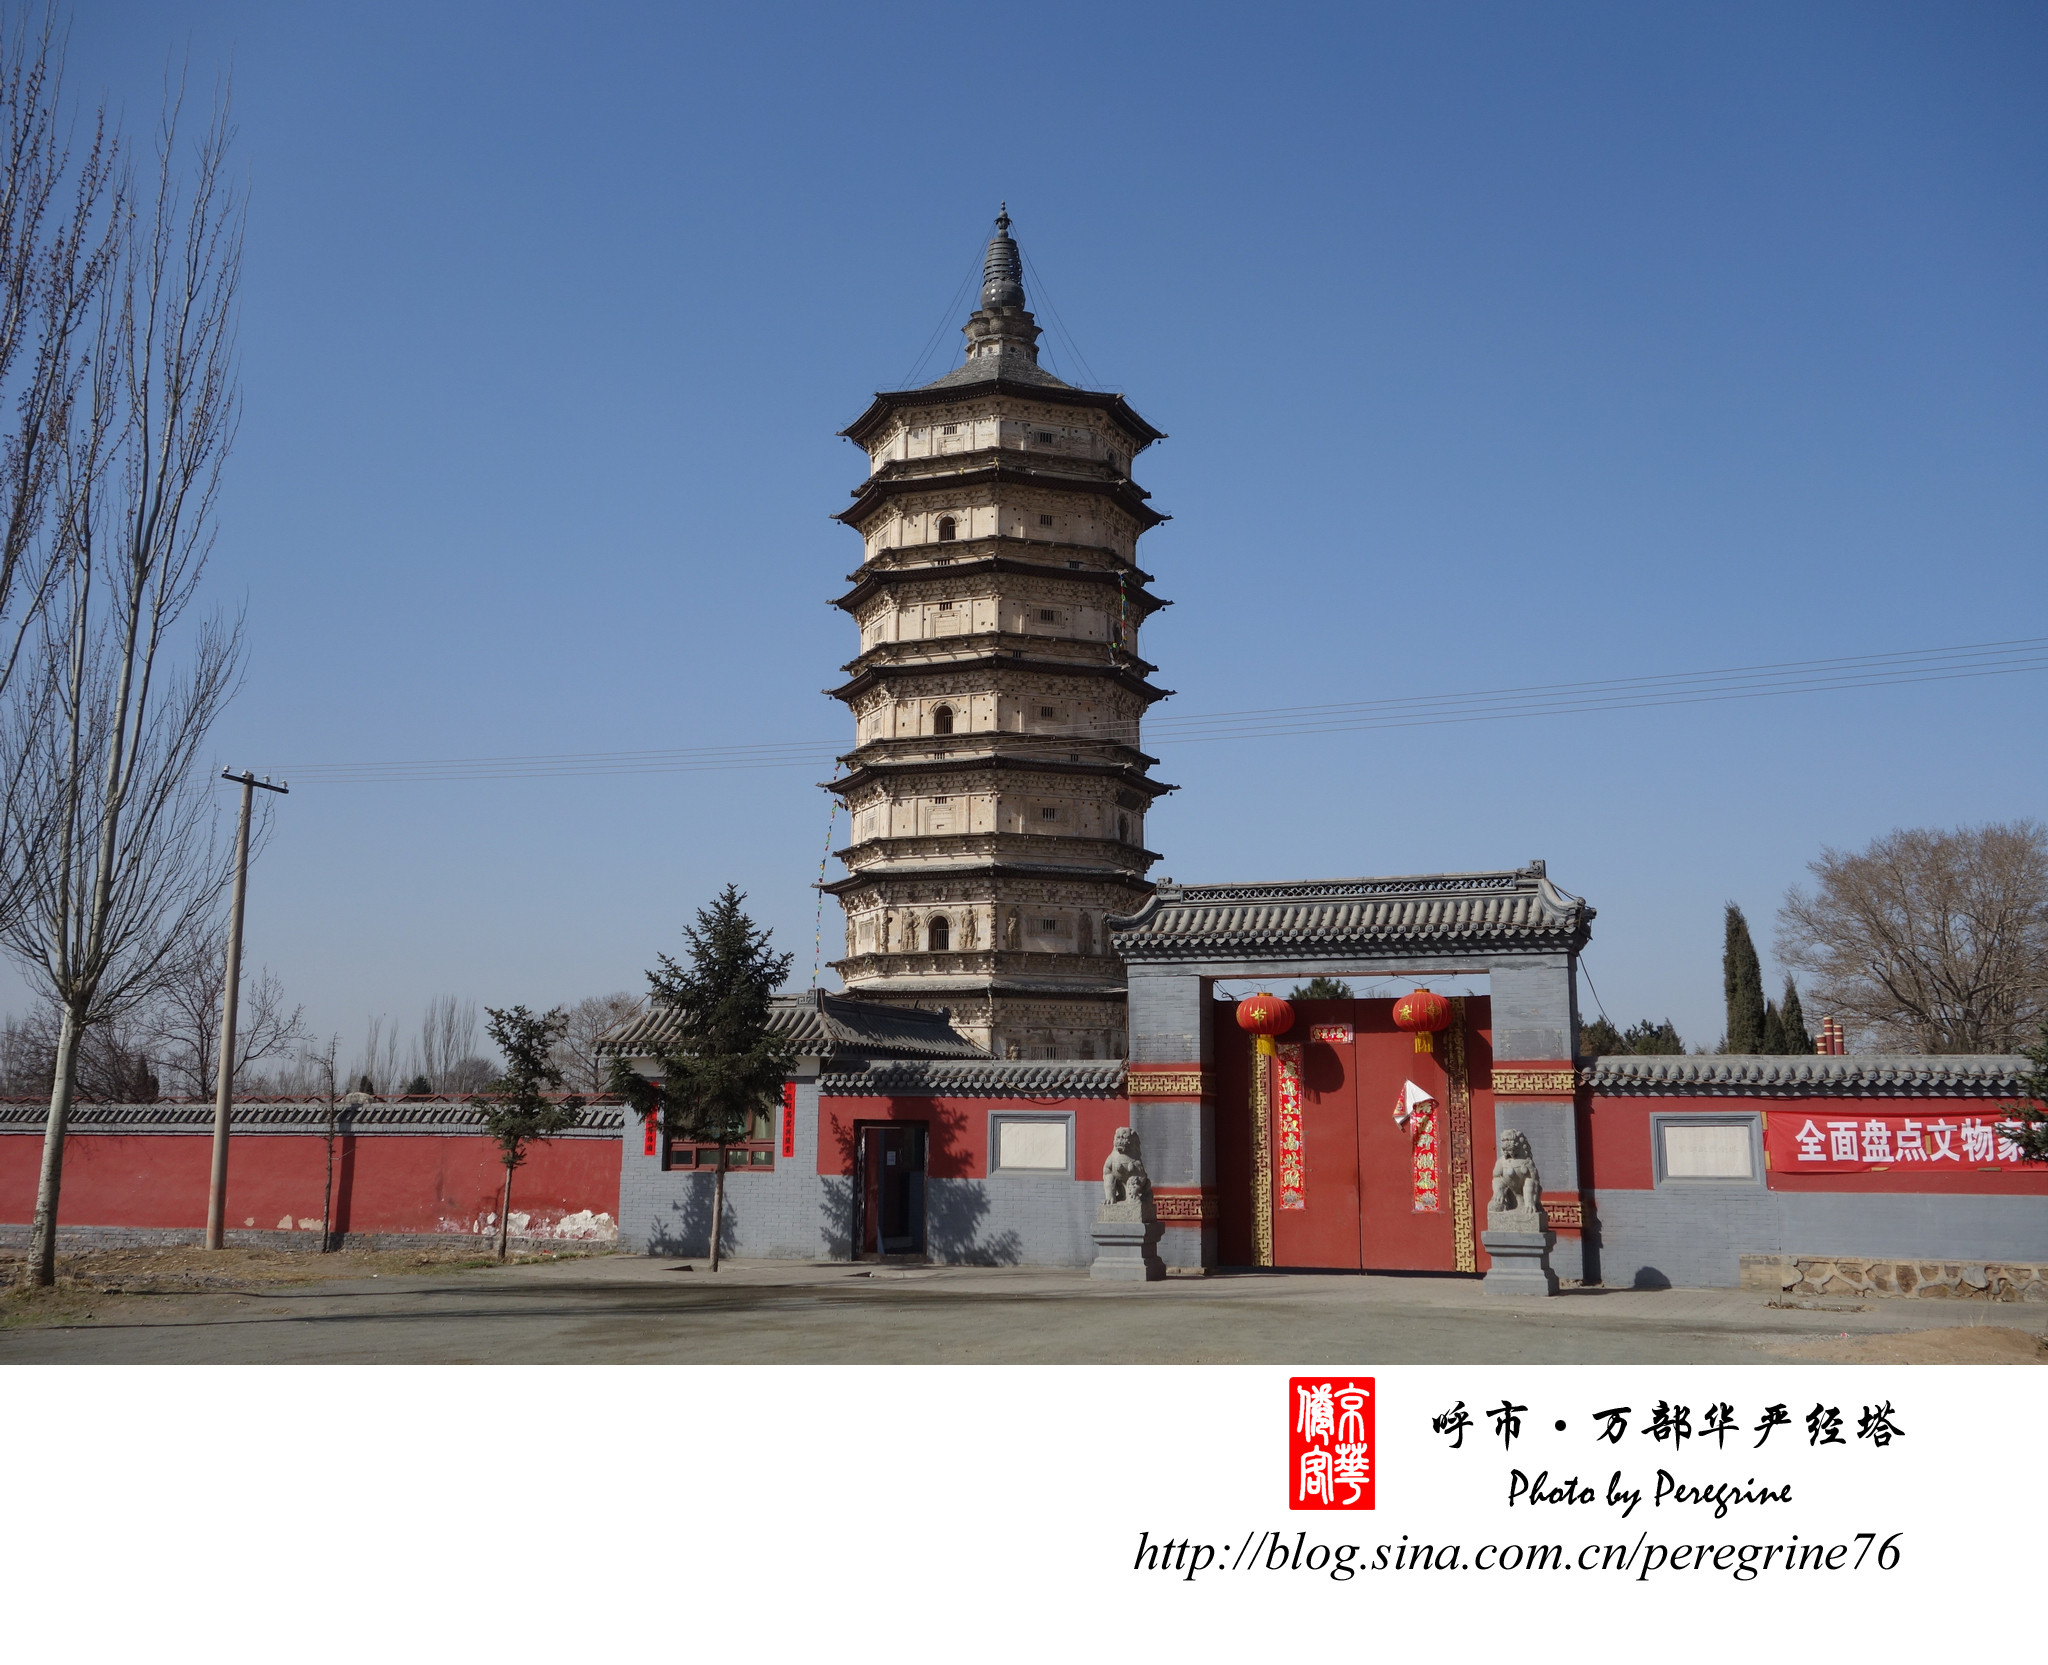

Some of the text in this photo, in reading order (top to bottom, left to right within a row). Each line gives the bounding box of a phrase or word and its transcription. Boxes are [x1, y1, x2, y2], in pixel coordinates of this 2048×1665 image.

[1795, 1118, 2048, 1163] 全面盘点文物家
